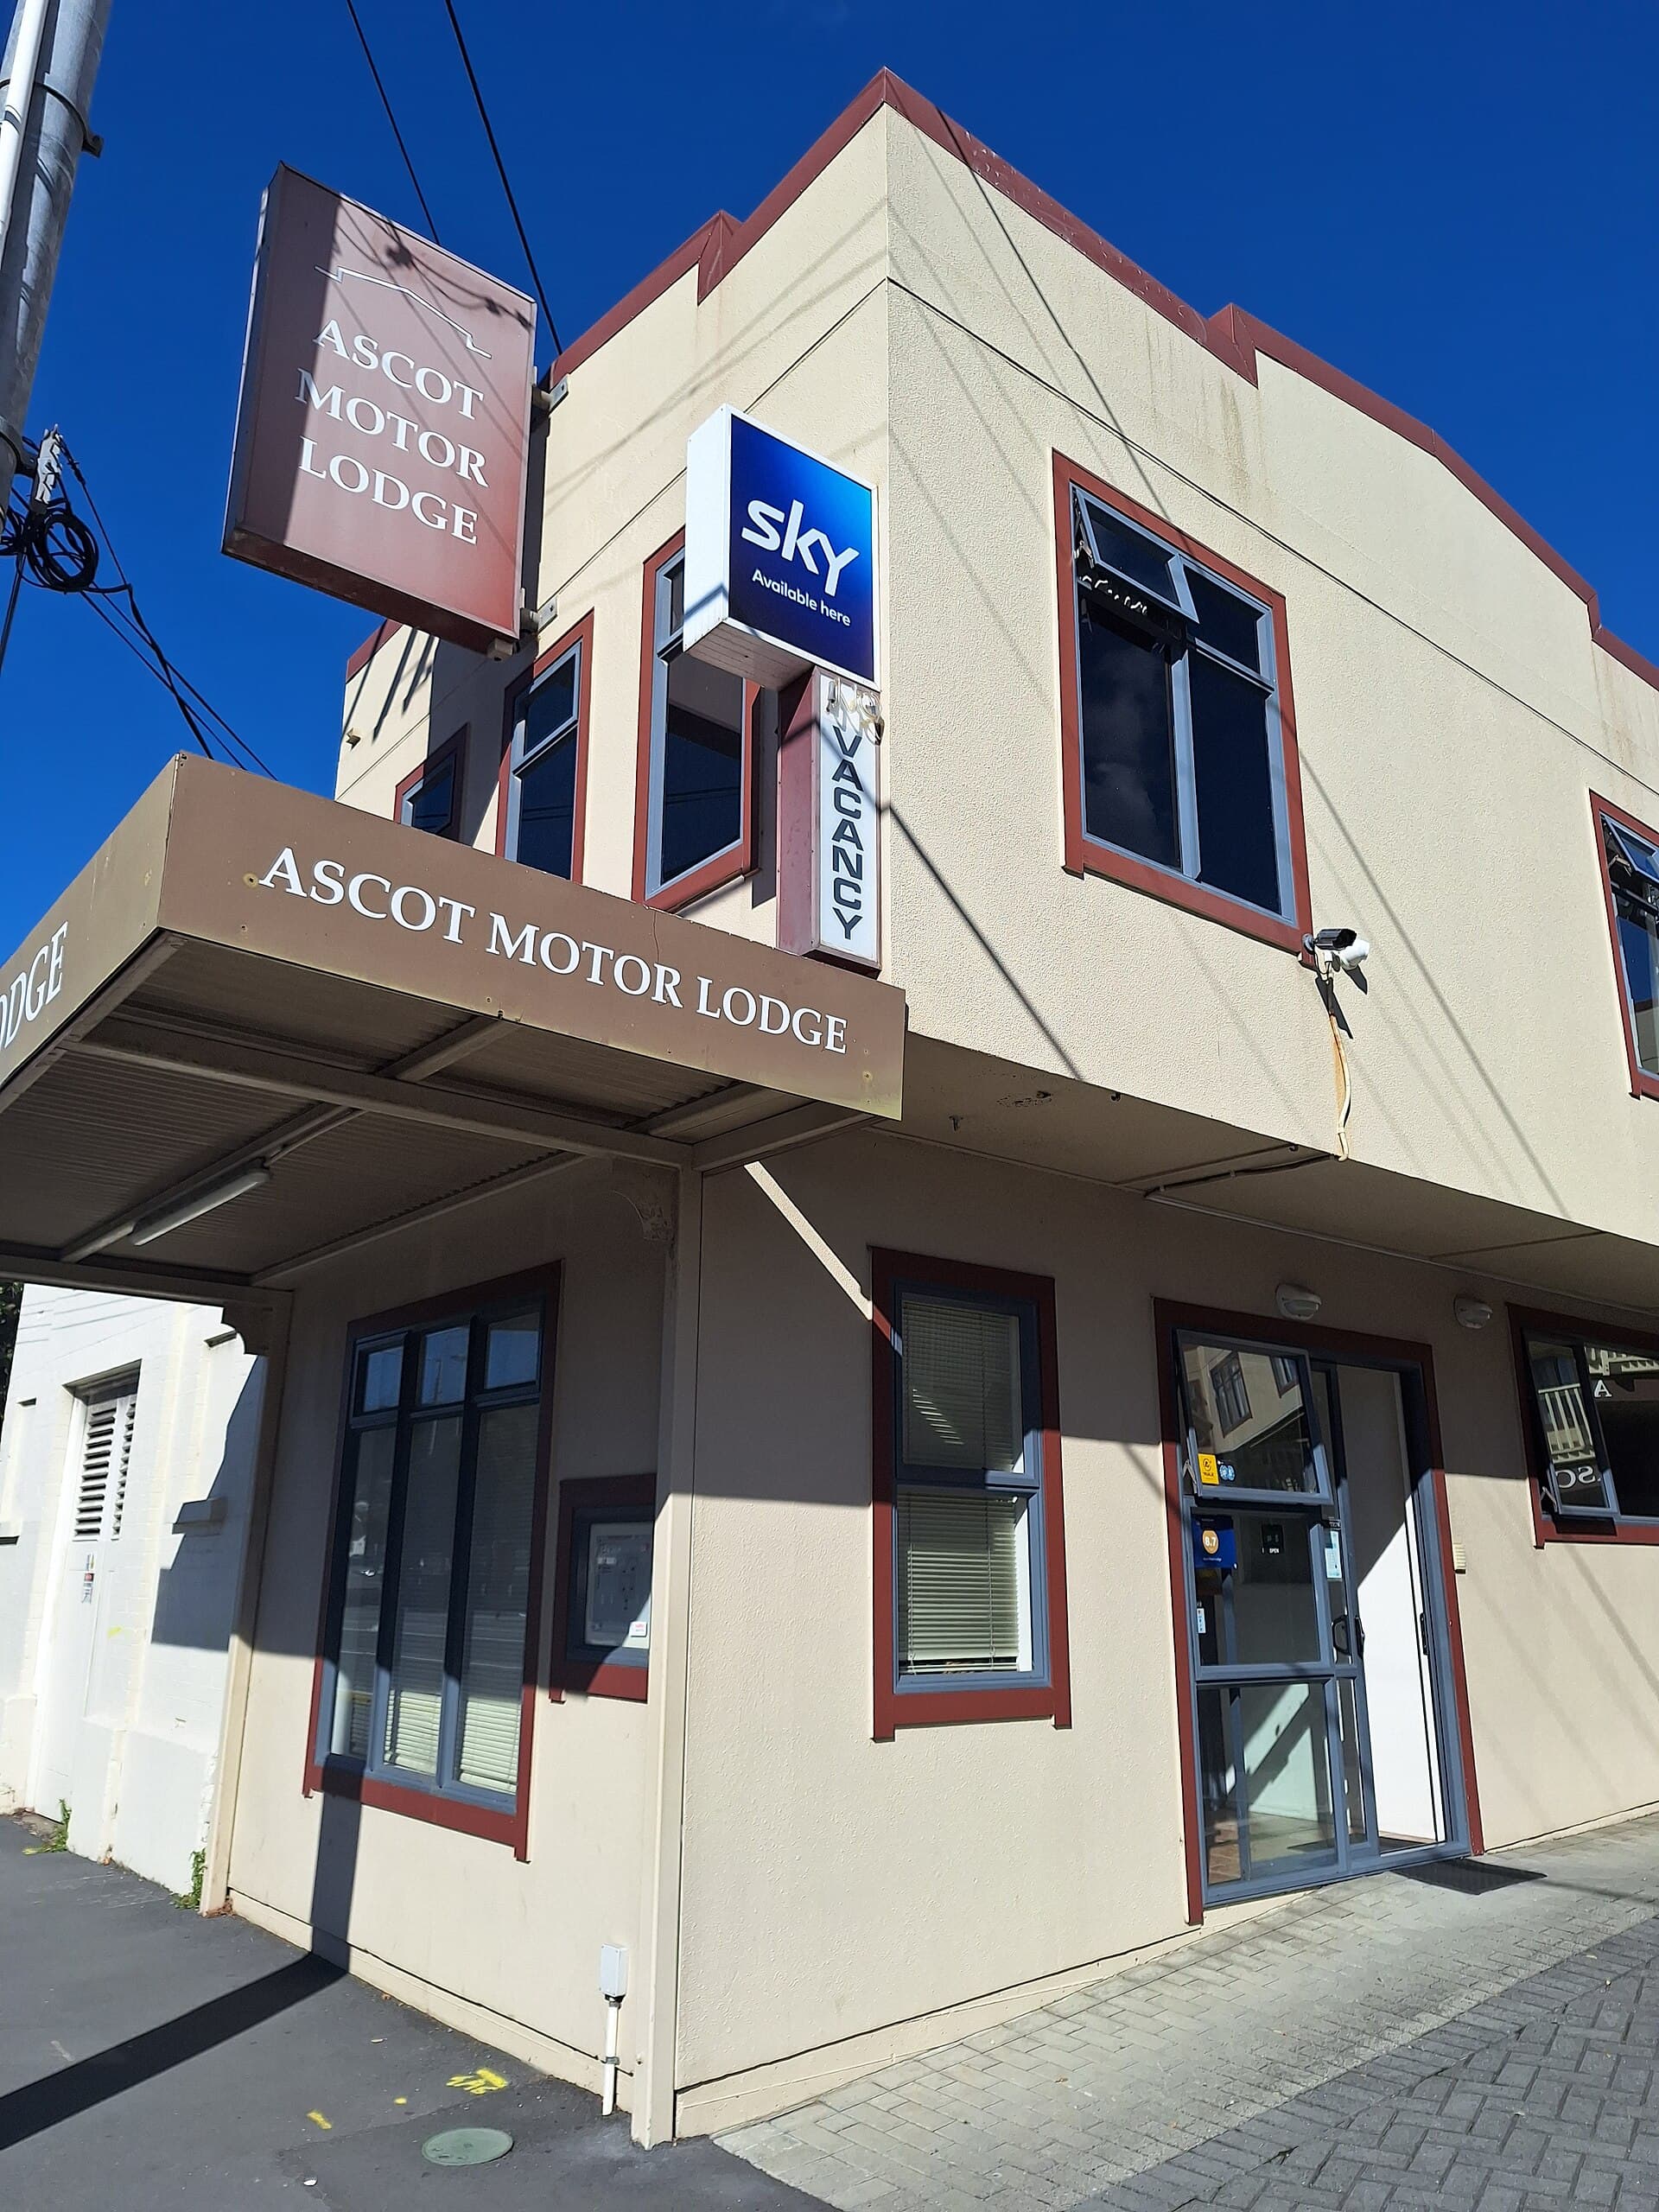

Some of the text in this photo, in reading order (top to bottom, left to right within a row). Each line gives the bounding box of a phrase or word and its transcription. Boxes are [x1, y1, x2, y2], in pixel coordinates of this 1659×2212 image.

[312, 318, 485, 422] ASCOT
[294, 367, 489, 488] MOTOR
[298, 435, 478, 545] LODGE
[752, 569, 851, 626] Available here
[831, 724, 864, 940] VACANCY
[258, 846, 848, 1055] ASCOT MOTOR LODGE
[1204, 1535, 1217, 1547] 8.7
